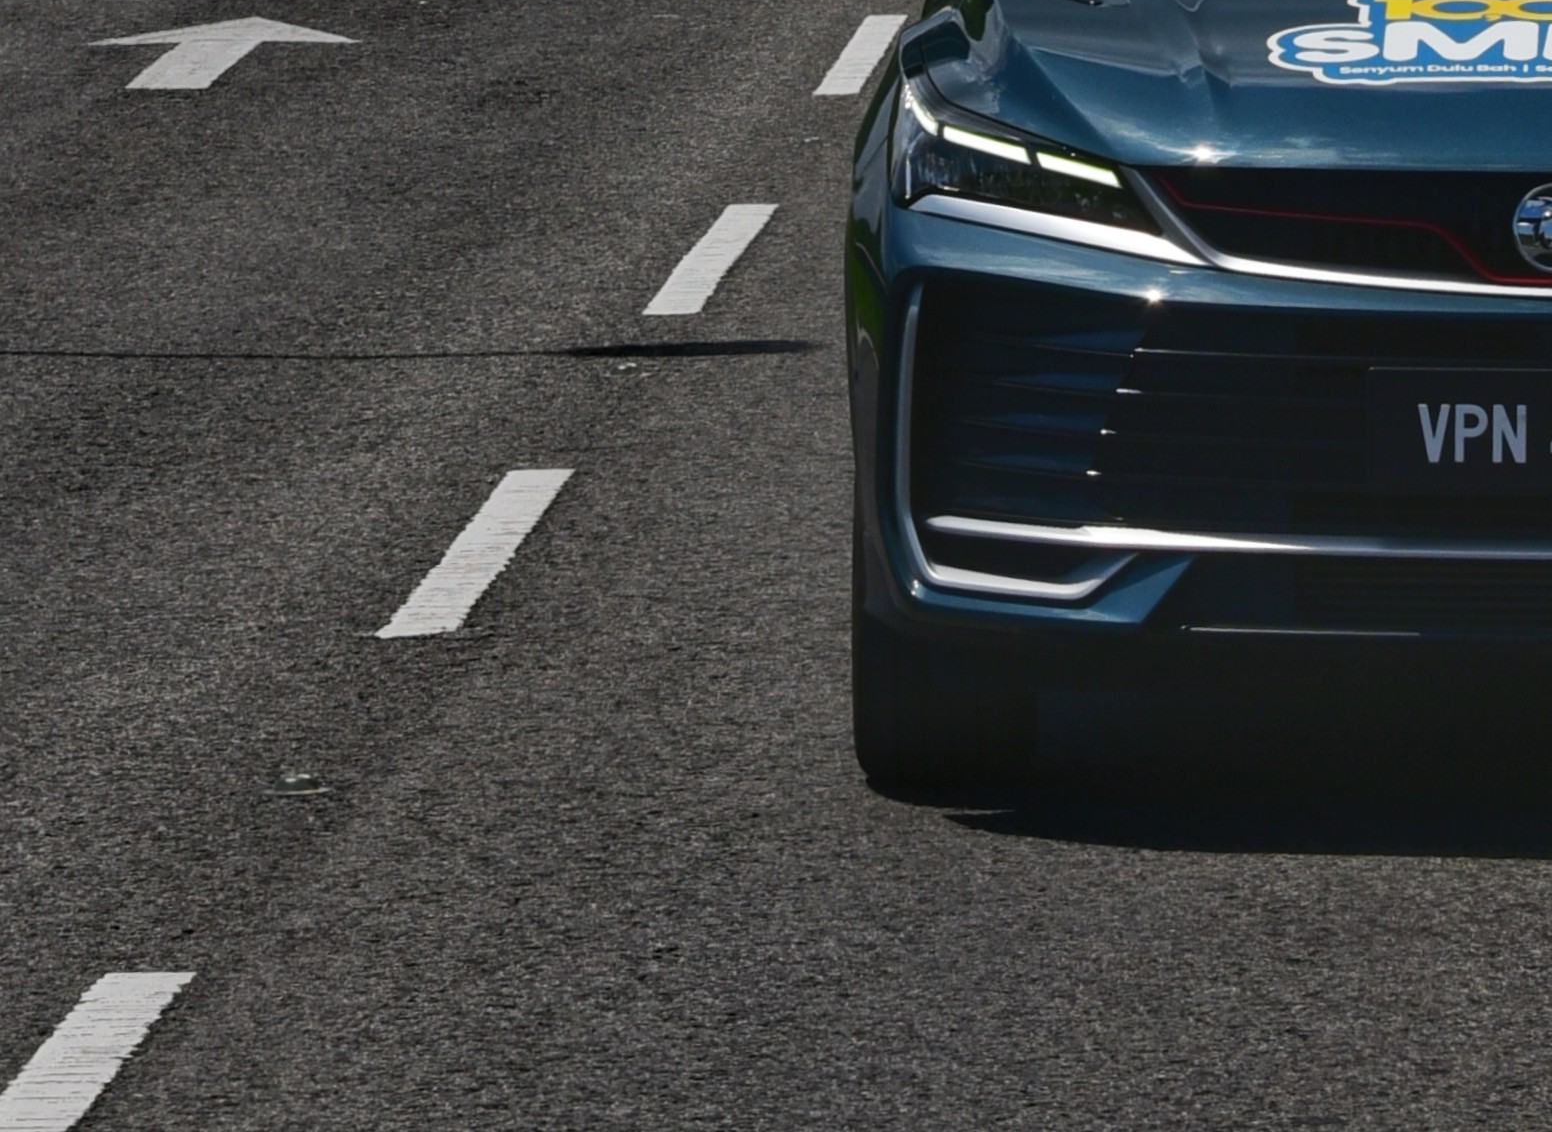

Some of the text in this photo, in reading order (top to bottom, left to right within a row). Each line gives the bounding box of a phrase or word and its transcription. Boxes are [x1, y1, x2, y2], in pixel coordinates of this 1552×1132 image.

[1426, 64, 1474, 73] Dulu
[1476, 64, 1517, 73] Bah
[1417, 403, 1527, 463] VPN
